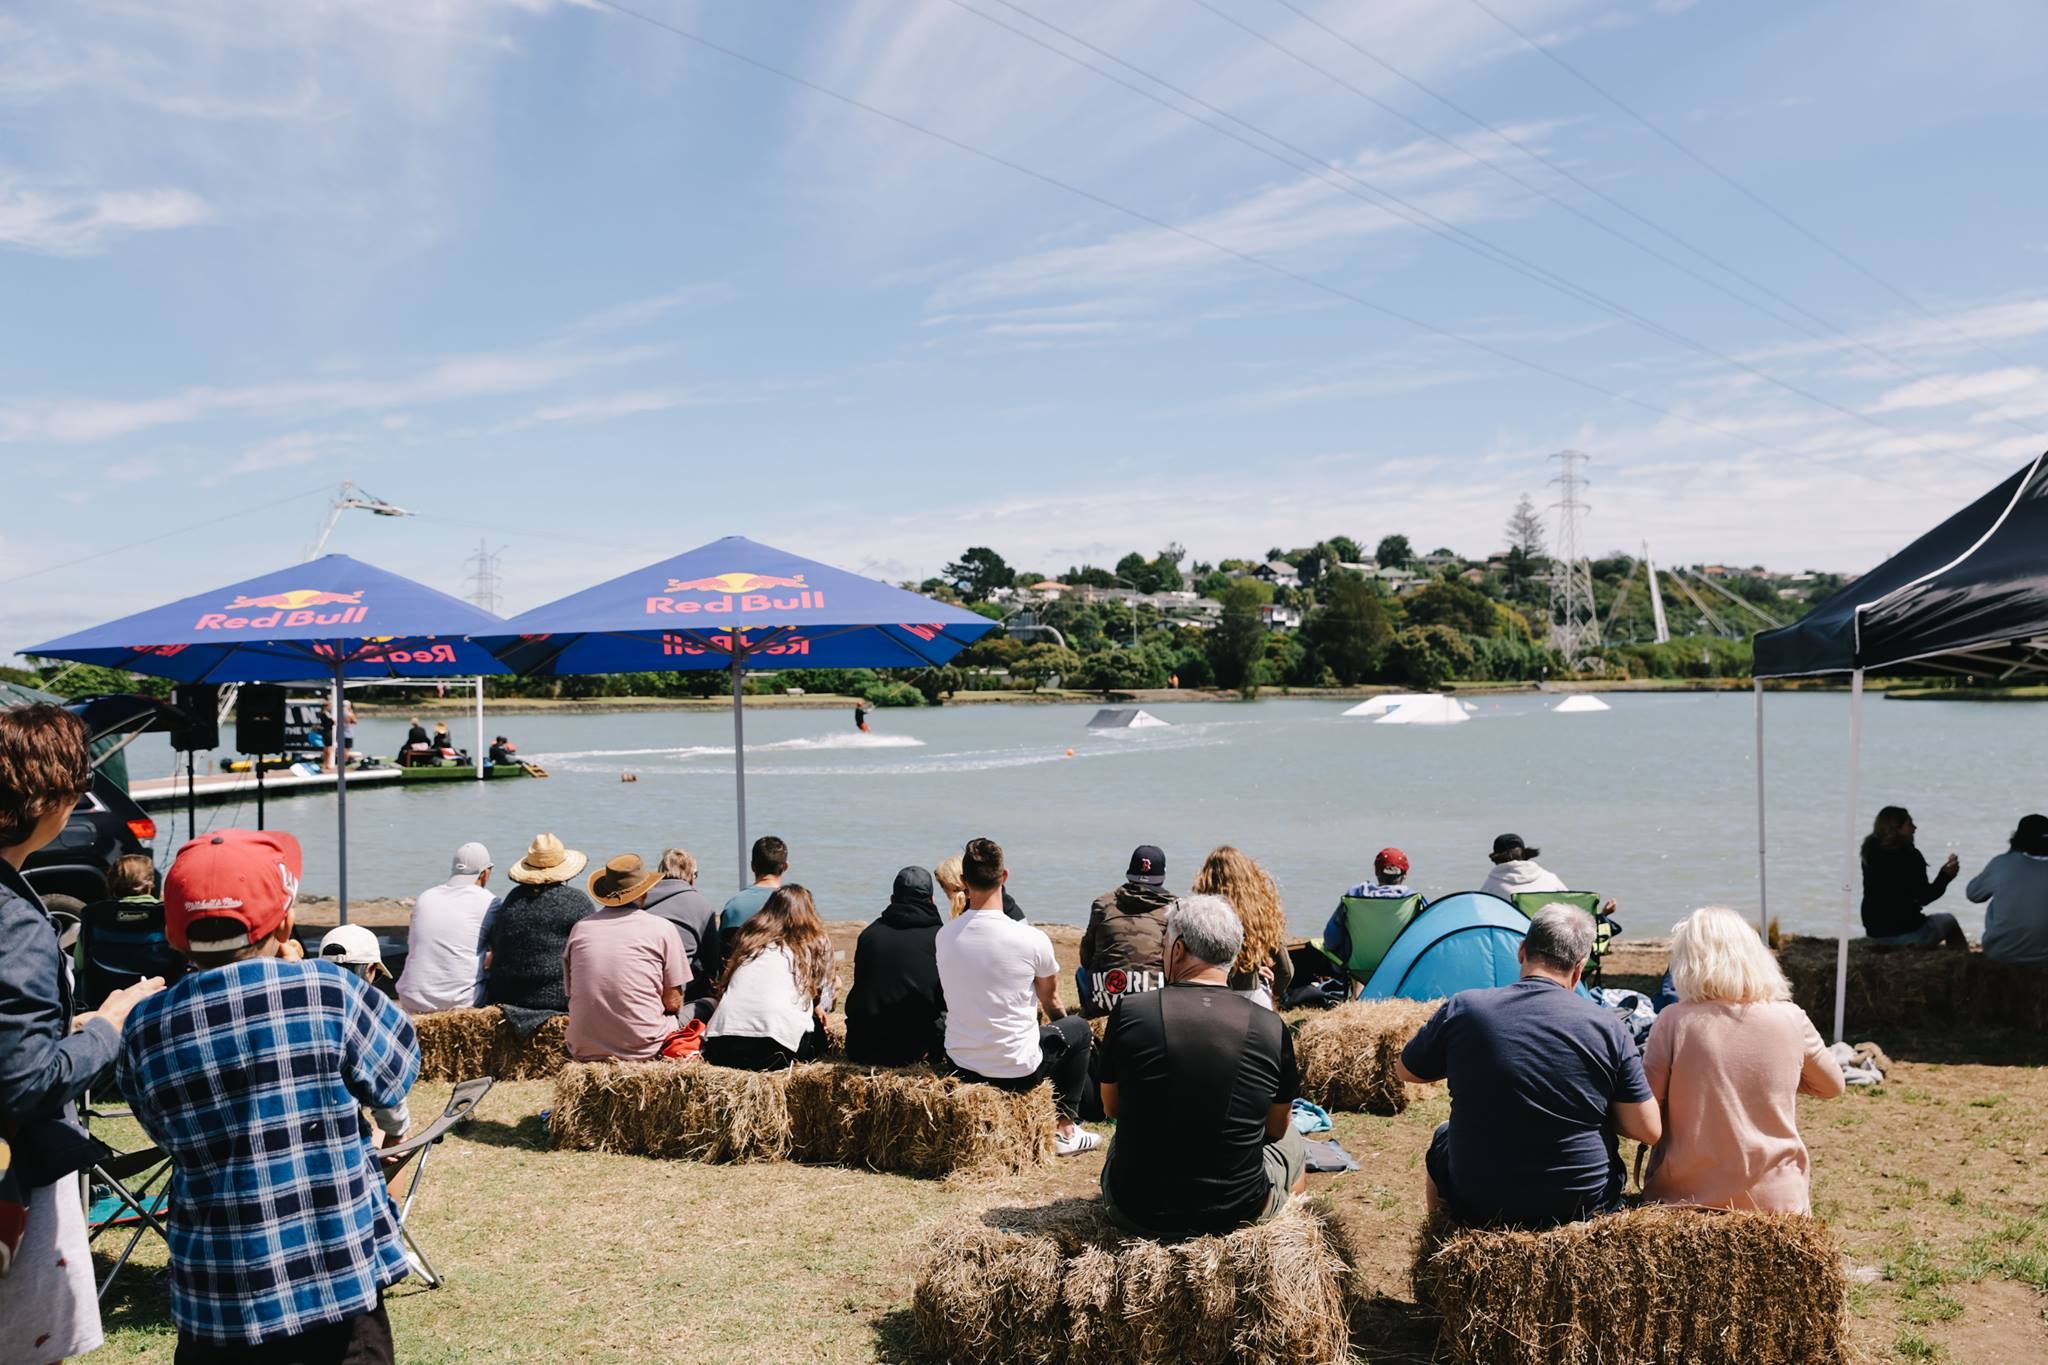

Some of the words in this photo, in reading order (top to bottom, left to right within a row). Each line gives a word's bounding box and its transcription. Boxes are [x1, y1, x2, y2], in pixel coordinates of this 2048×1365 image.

[646, 595, 733, 614] Red
[741, 591, 825, 612] Bull
[194, 610, 284, 630] Red
[284, 606, 369, 627] Bull
